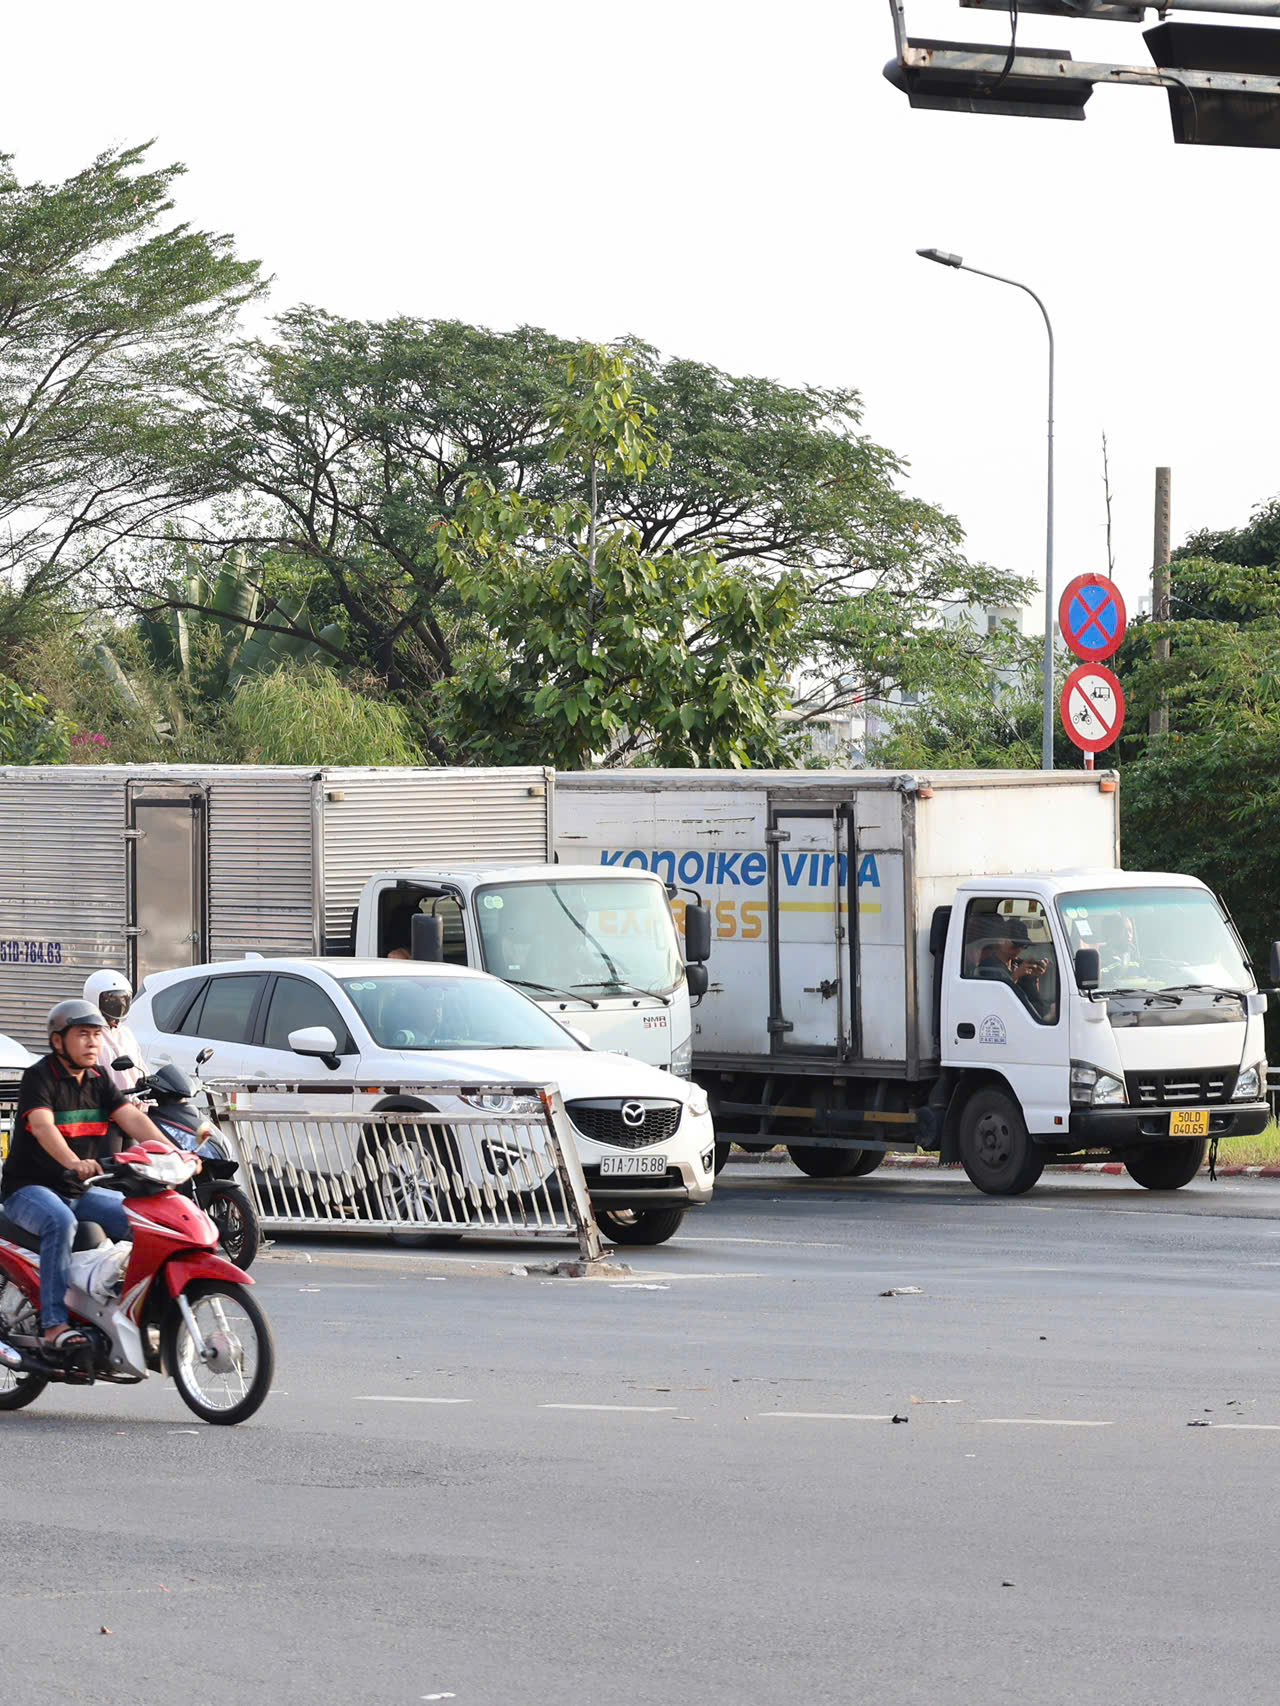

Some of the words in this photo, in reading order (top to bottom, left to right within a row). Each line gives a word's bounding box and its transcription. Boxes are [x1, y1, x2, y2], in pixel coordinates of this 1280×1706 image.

[0, 940, 62, 964] 51D-764.63
[643, 1015, 667, 1023] NMR
[643, 1021, 668, 1029] 310
[1178, 1111, 1201, 1123] 50LD
[1173, 1123, 1205, 1135] 040.65
[602, 1157, 665, 1173] 51A-715.88
